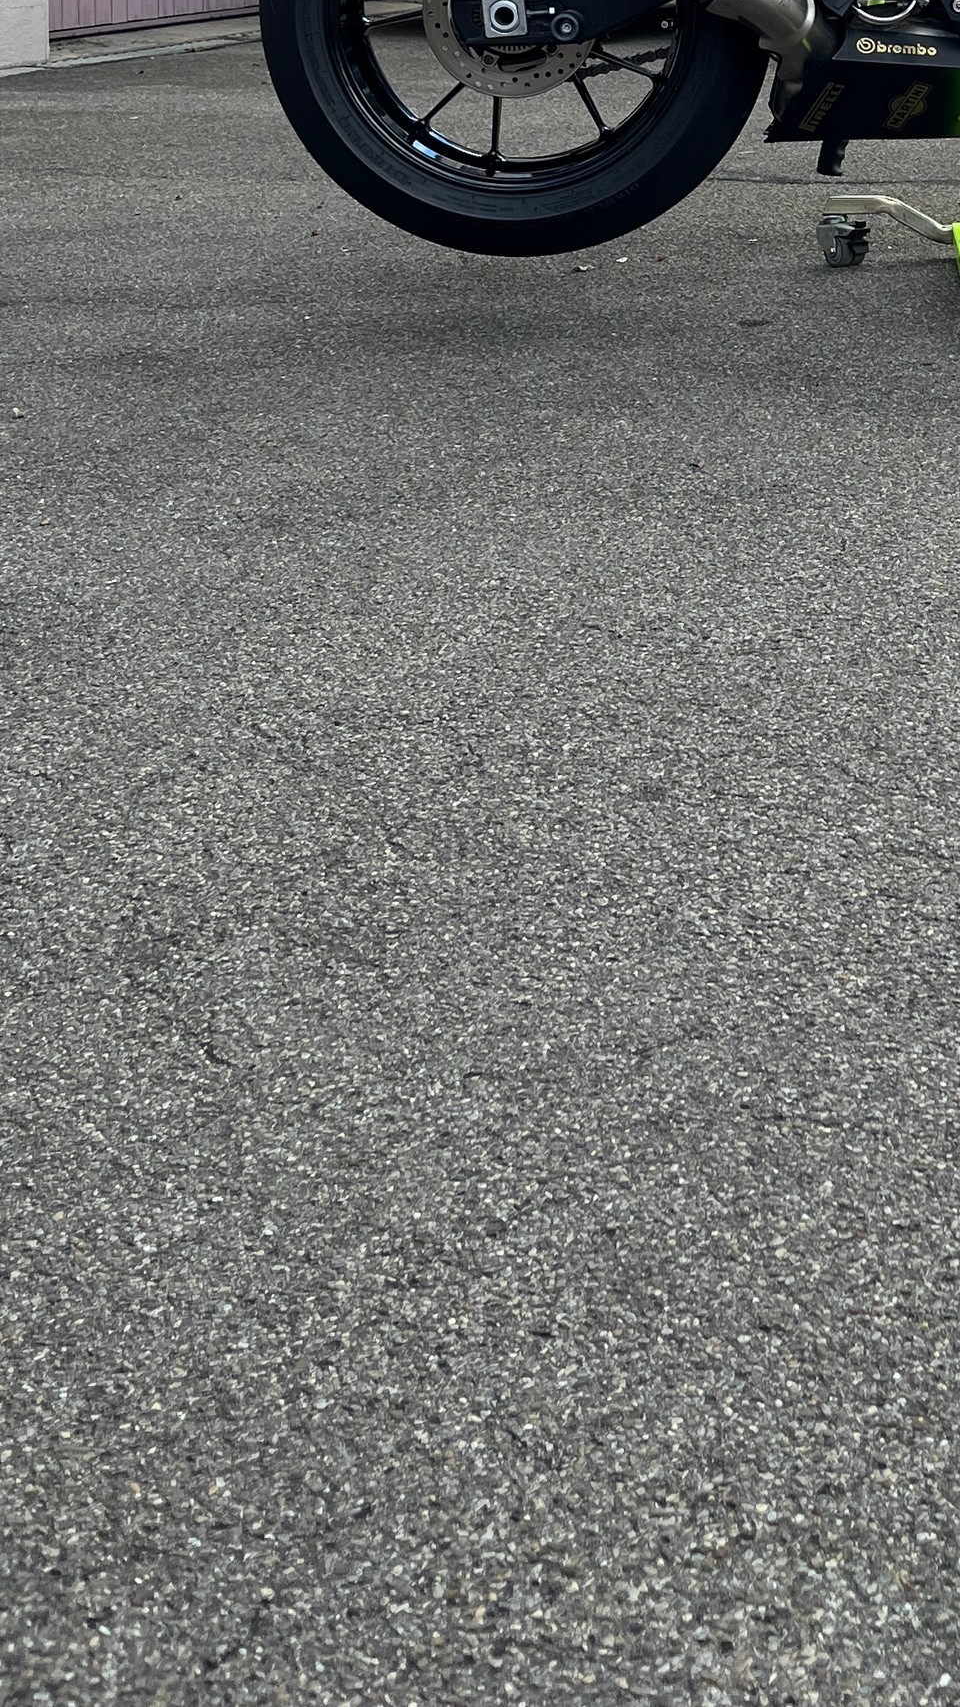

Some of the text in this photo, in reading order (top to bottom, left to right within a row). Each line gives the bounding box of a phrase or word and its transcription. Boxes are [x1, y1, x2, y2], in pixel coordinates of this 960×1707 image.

[876, 40, 938, 56] brembo
[798, 80, 846, 132] PIRELLI
[890, 84, 926, 127] MARTINI
